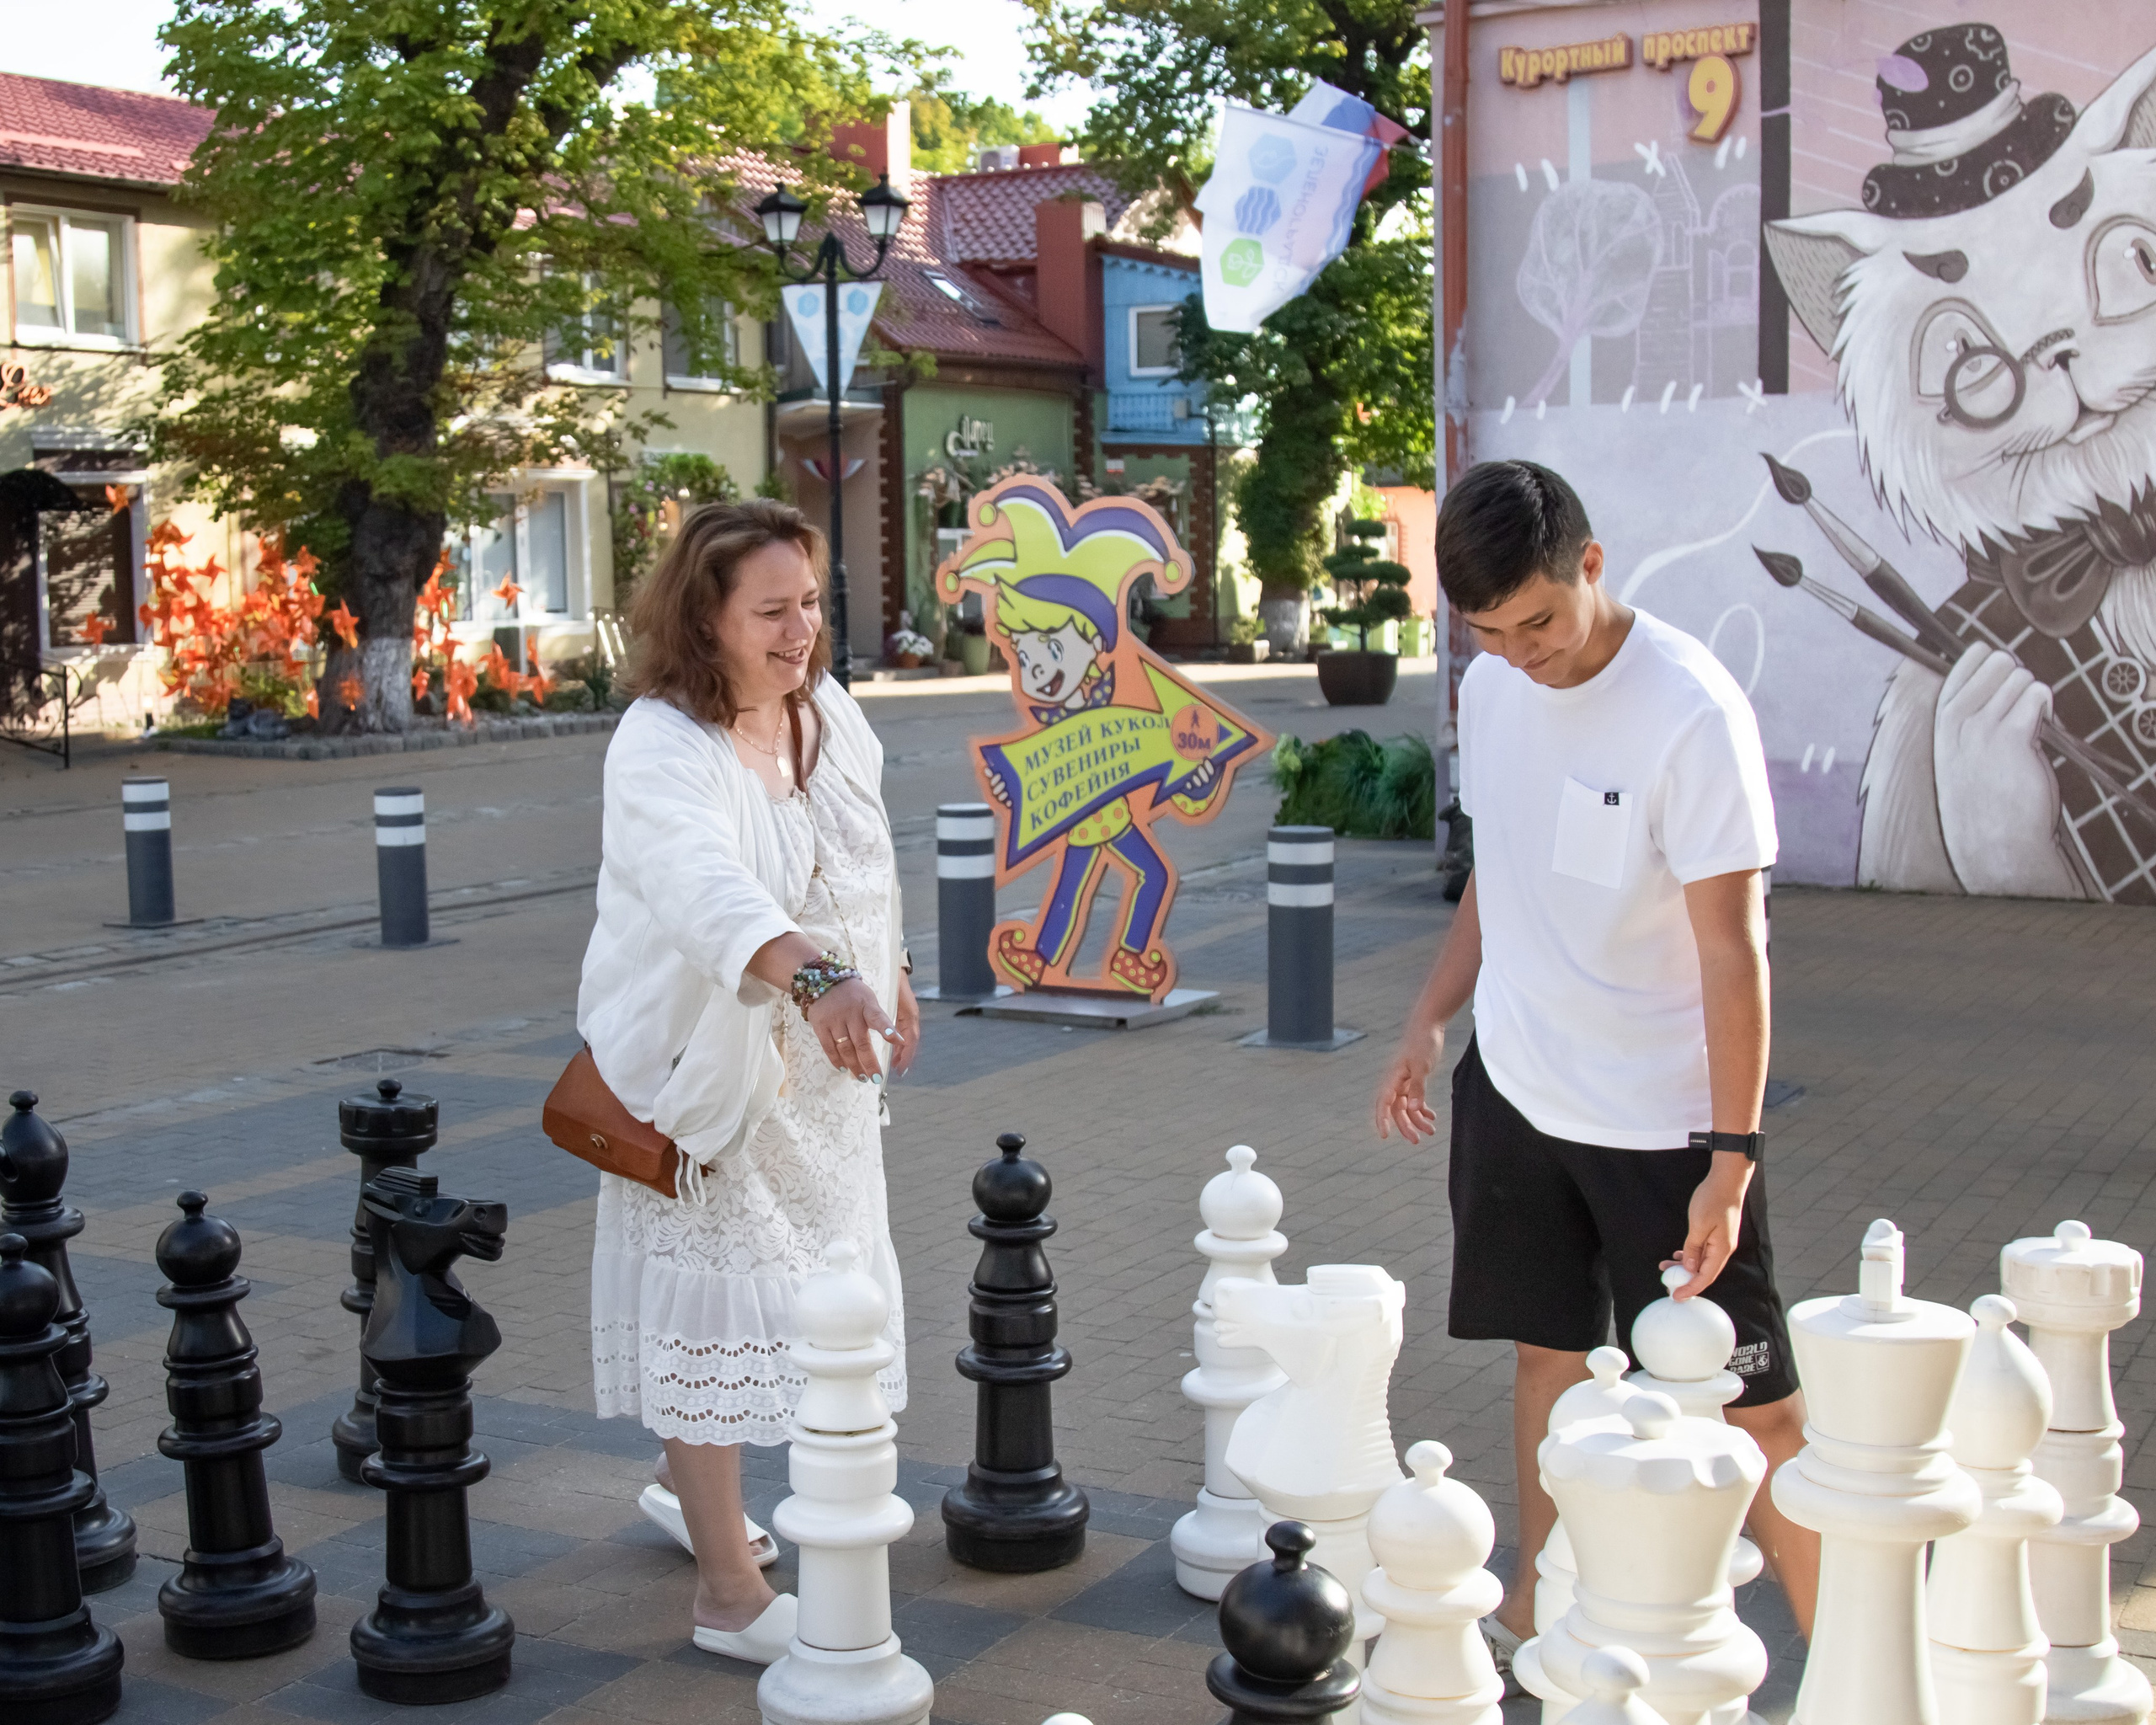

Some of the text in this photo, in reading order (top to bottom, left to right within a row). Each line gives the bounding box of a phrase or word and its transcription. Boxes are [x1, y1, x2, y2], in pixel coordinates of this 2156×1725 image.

[1500, 24, 1754, 86] Курортный проспект
[1688, 55, 1738, 142] 9
[1025, 716, 1171, 776] МУЗЕЙ КУКОЛ
[1027, 738, 1141, 802] СУВЕНИРЫ
[1030, 761, 1130, 831] КОФЕЙНЯ
[1729, 1354, 1754, 1367] GONE
